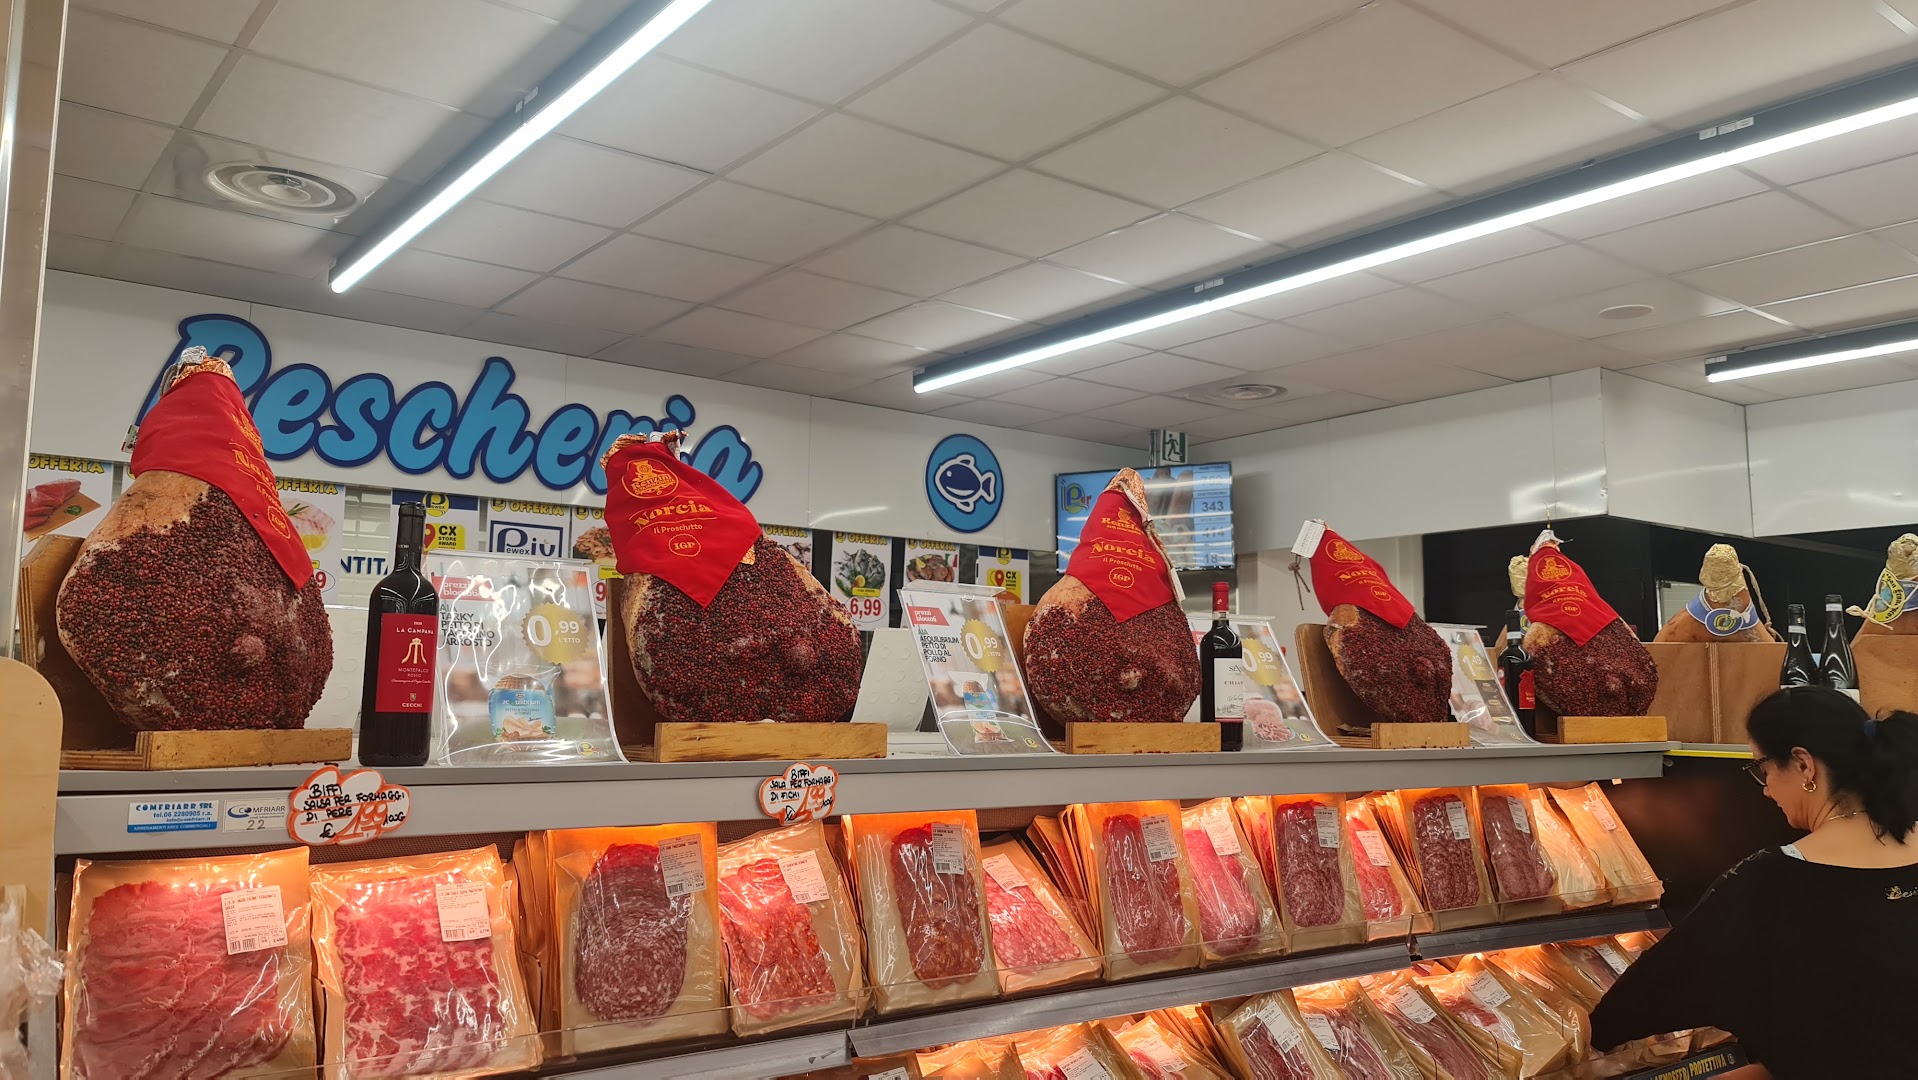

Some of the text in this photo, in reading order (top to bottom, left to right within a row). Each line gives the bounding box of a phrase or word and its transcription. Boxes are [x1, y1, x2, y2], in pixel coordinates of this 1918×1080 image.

[136, 314, 764, 505] Pescheria
[28, 455, 104, 474] OFFERTA
[509, 501, 564, 517] OFFERTA
[1202, 500, 1224, 512] 343
[633, 500, 713, 530] Norcia
[438, 525, 457, 537] CX
[661, 524, 703, 534] Prosciutto
[765, 525, 809, 539] OFFERTA
[673, 541, 696, 550] IGP
[848, 533, 888, 546] OFFERTA
[1090, 541, 1156, 564] Norcia
[340, 555, 388, 575] NTIT
[1109, 557, 1143, 572] Prosciutto
[1005, 570, 1017, 580] CX
[1112, 573, 1131, 582] IGP
[850, 597, 882, 619] 6,99
[440, 612, 475, 621] TARKY
[407, 627, 434, 635] CAMPANA
[441, 620, 473, 630] PETTO
[558, 636, 581, 644] L'ETTO
[920, 635, 960, 645] AEQUILIBRIUM
[921, 642, 947, 650] PETTO DI
[923, 648, 952, 657] POLLO AL
[925, 655, 947, 663] FORNO
[790, 780, 803, 789] PER
[308, 783, 343, 799] BIFFI
[770, 790, 800, 802] DI FICHI
[303, 790, 405, 811] SALSA PER FORMAGGI
[135, 802, 197, 812] COMFRIARR
[326, 806, 353, 819] PERE
[173, 810, 201, 818] 2280905
[1688, 1053, 1728, 1077] PROTETTIVA
